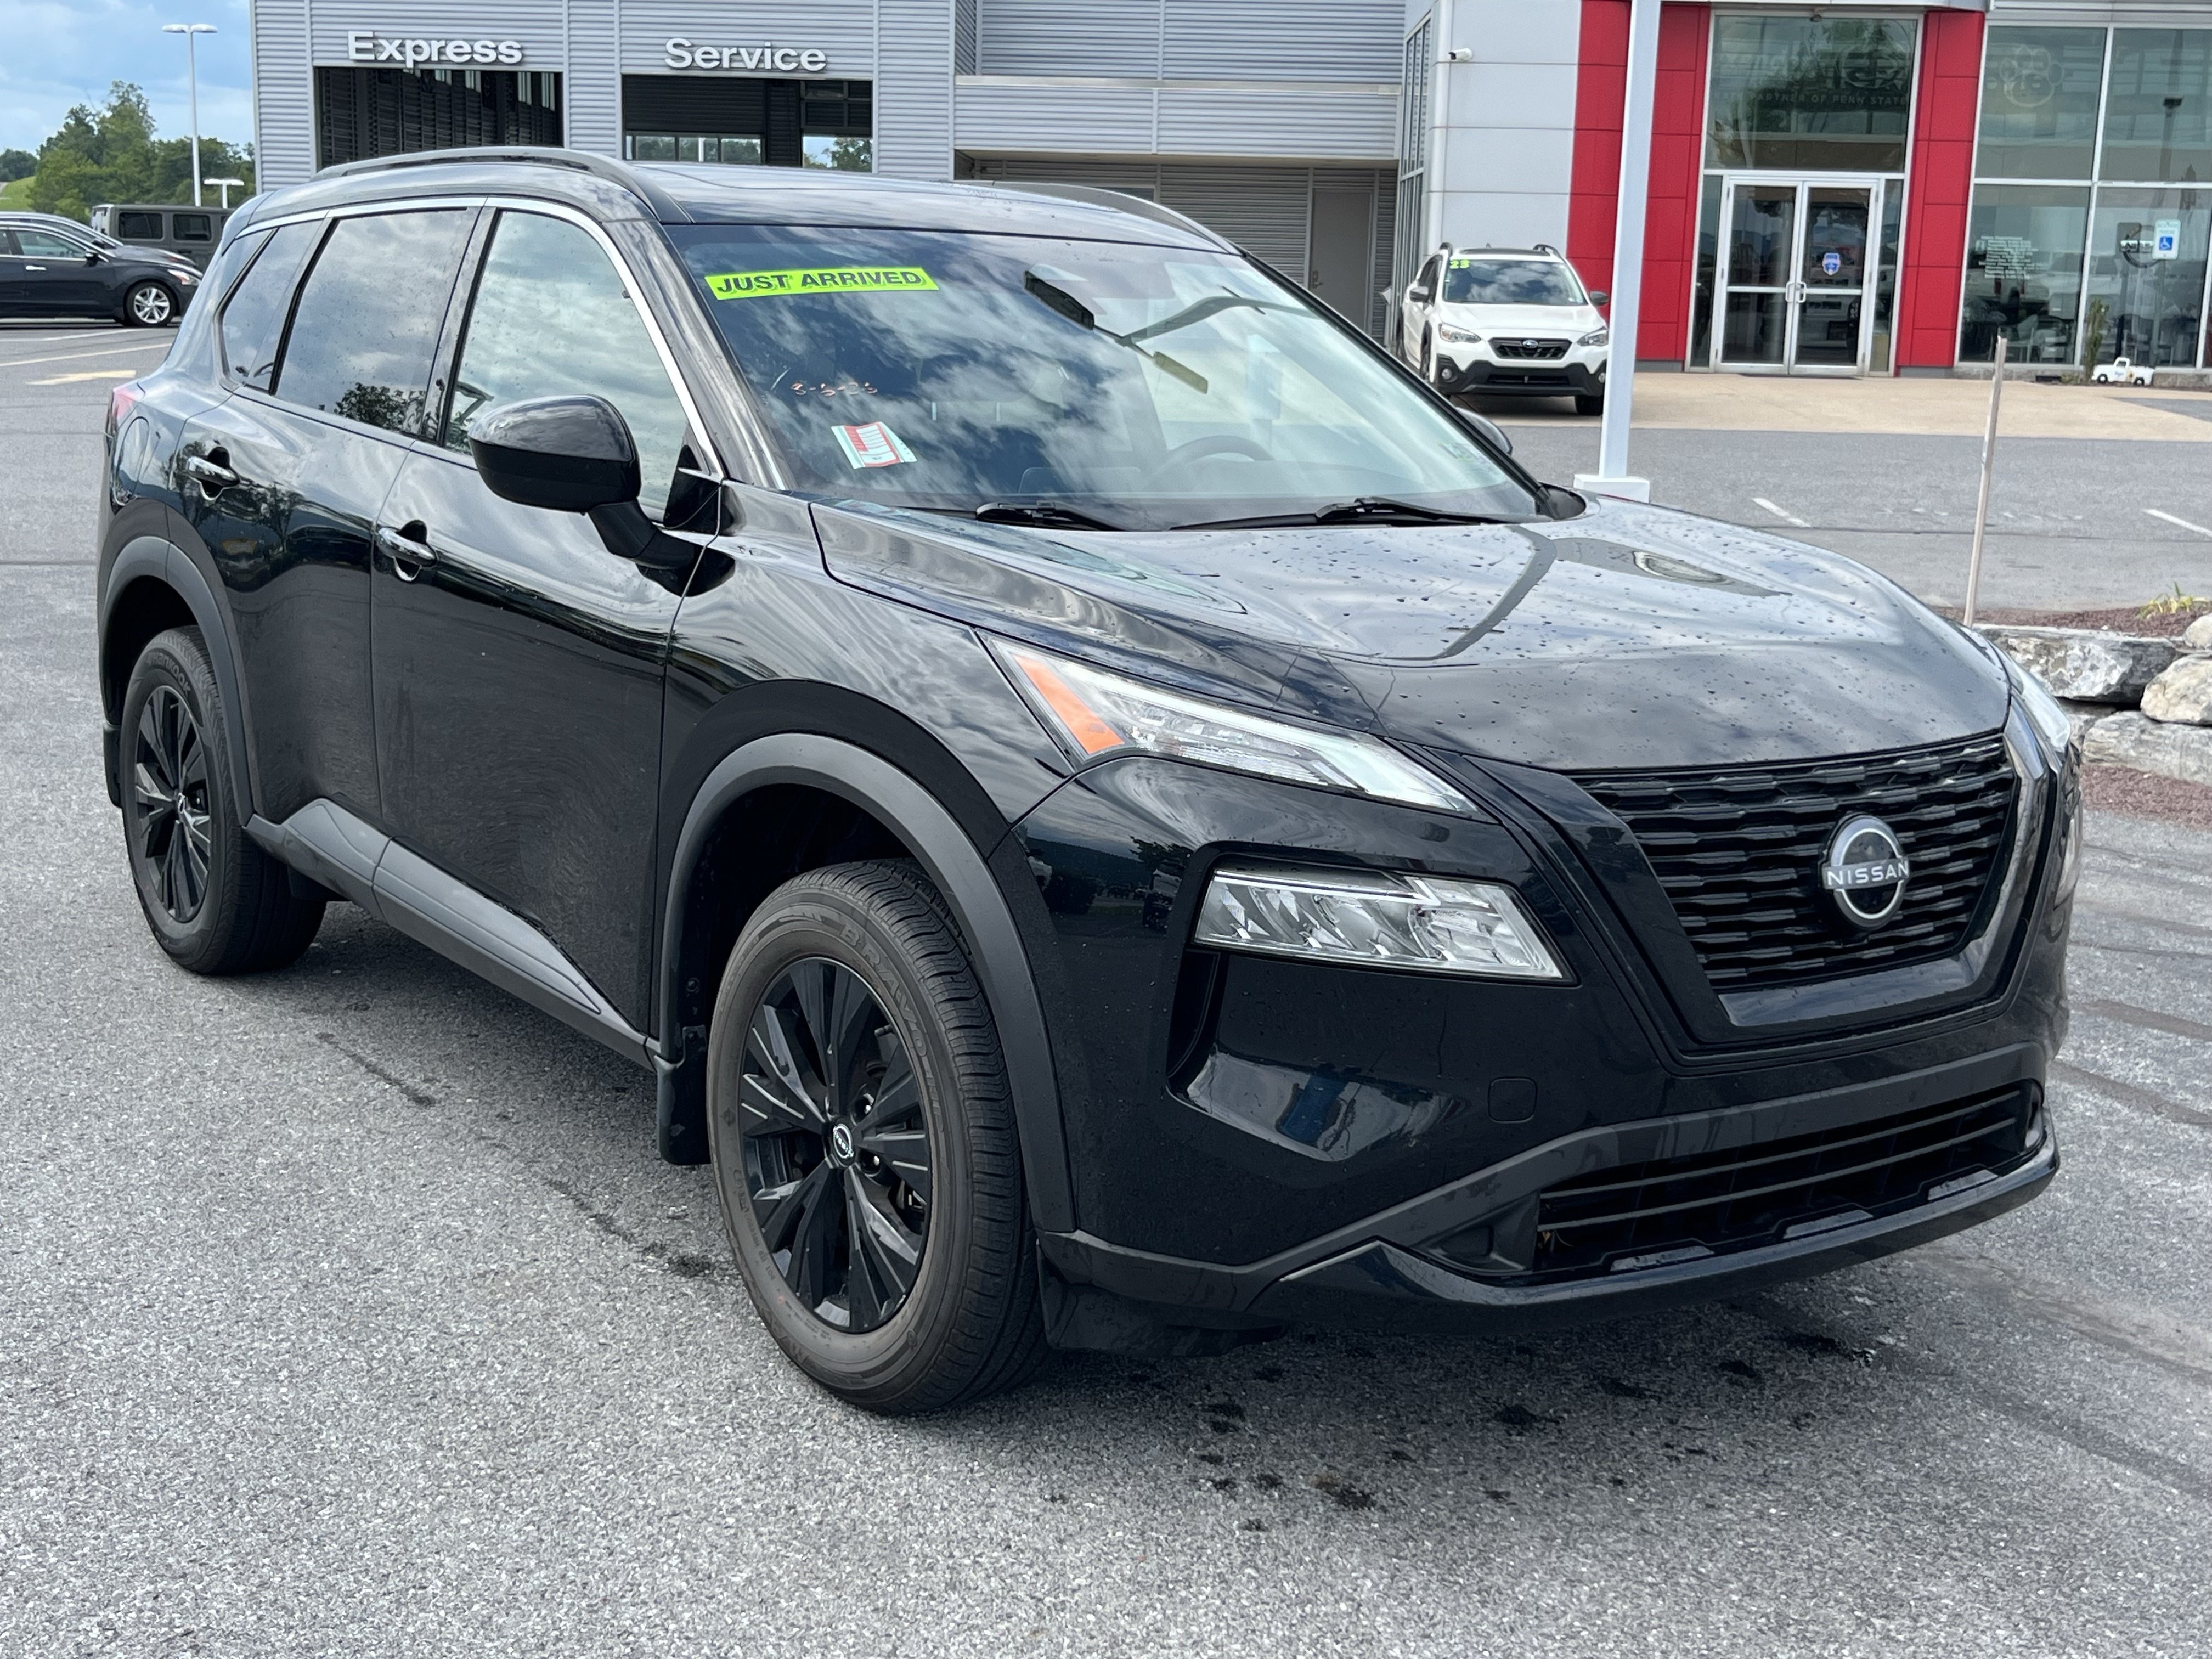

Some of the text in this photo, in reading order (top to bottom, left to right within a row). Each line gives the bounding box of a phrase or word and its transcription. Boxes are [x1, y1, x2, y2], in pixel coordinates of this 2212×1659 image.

[348, 31, 522, 68] Express
[664, 38, 826, 71] Service
[716, 272, 924, 294] JUST ARRIVED
[1827, 860, 1909, 886] NISSAN
